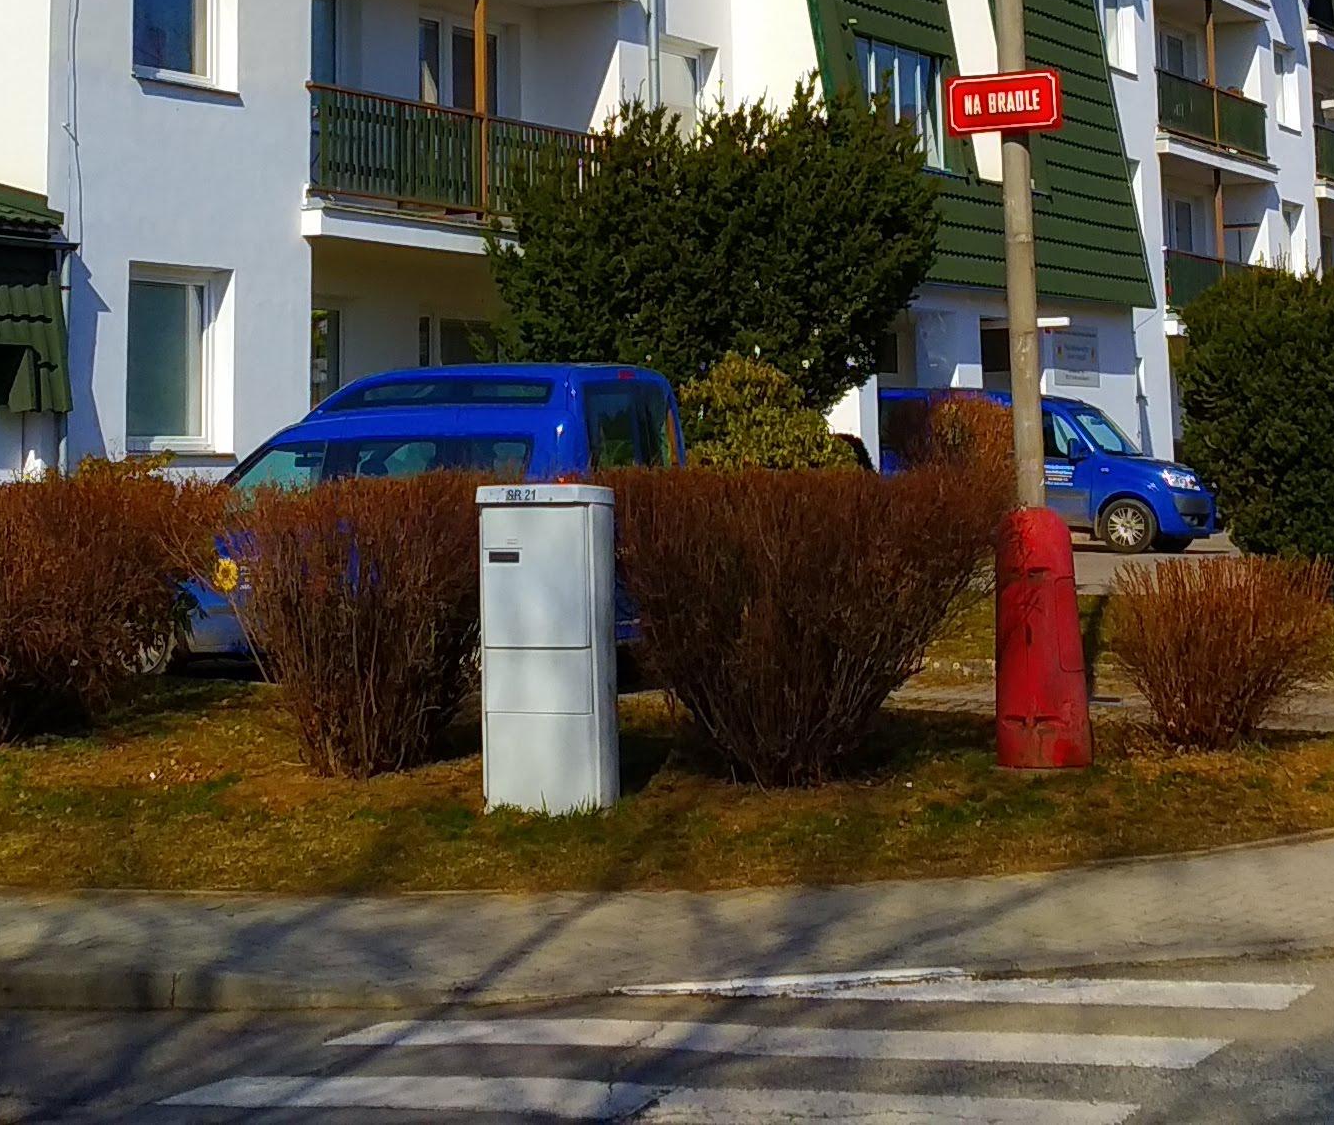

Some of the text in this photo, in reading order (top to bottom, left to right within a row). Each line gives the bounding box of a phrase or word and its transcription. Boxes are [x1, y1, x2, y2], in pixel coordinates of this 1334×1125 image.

[964, 88, 1041, 116] NA BRADLE
[505, 489, 536, 501] SR 21
